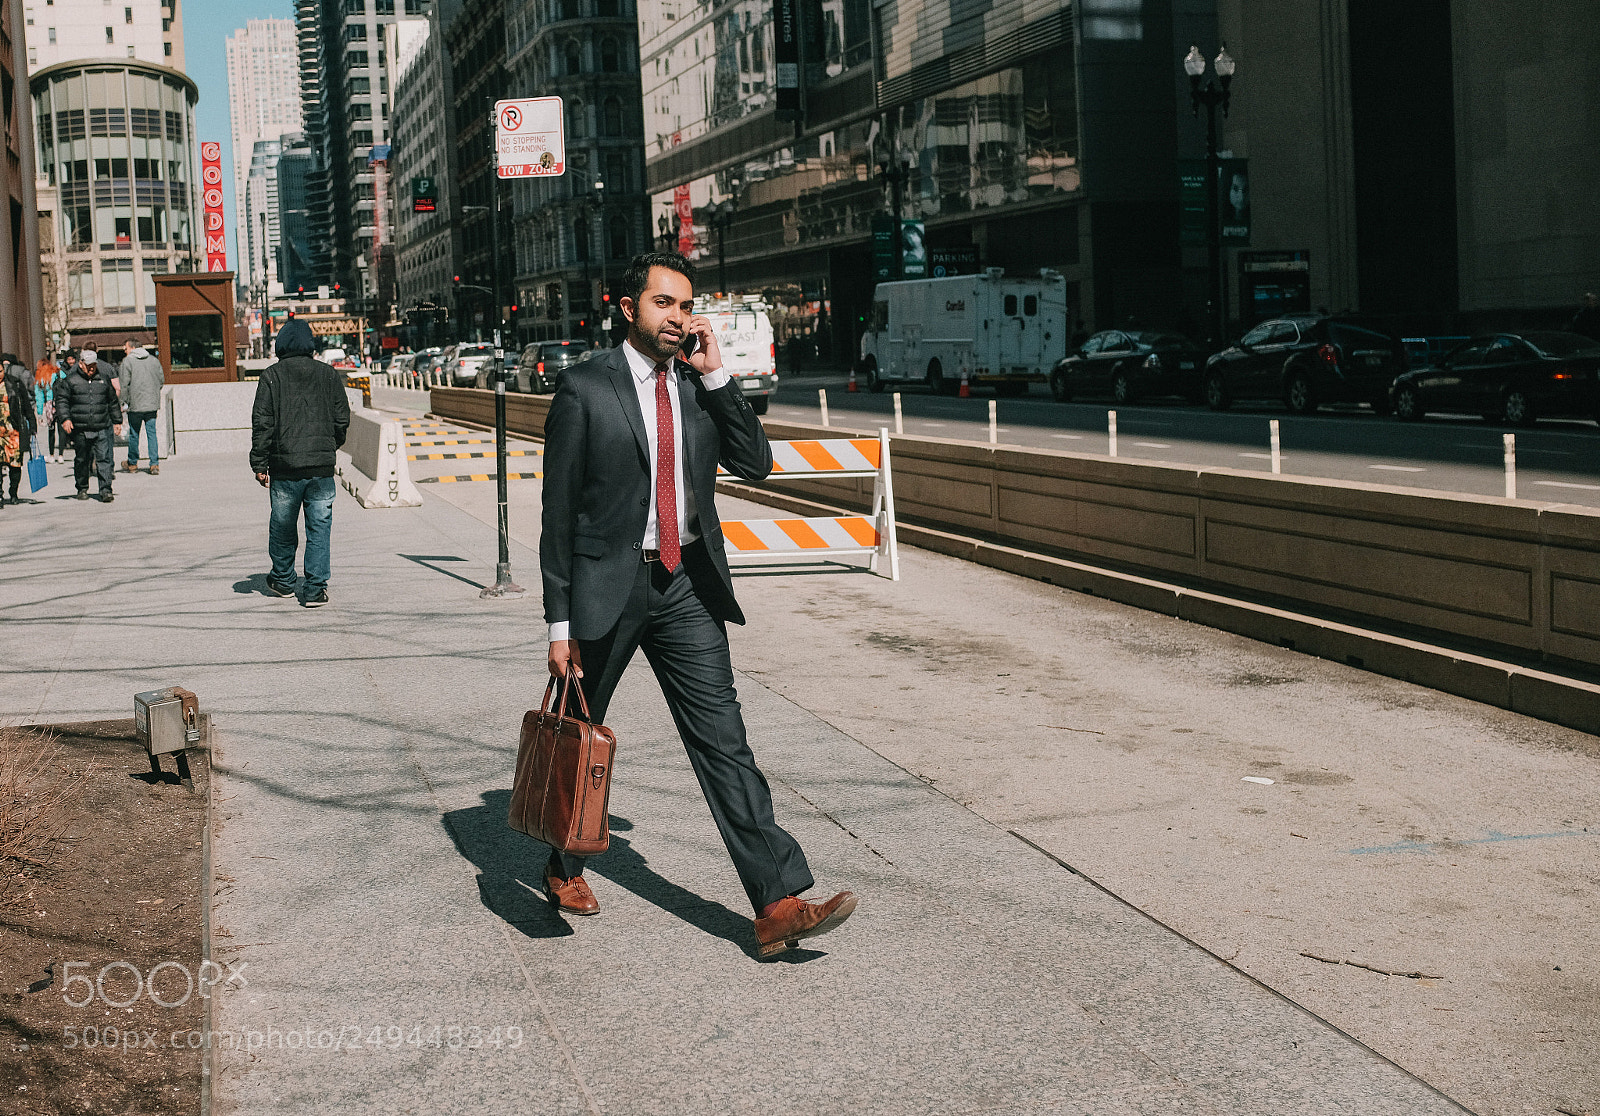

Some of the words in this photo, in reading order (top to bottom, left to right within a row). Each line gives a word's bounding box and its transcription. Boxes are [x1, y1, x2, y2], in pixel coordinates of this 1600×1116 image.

[501, 137, 511, 146] NO
[513, 135, 546, 144] STOPPING
[501, 146, 511, 154] NO
[513, 144, 547, 154] STANDING
[501, 165, 524, 176] TOW
[932, 253, 975, 263] PARKING
